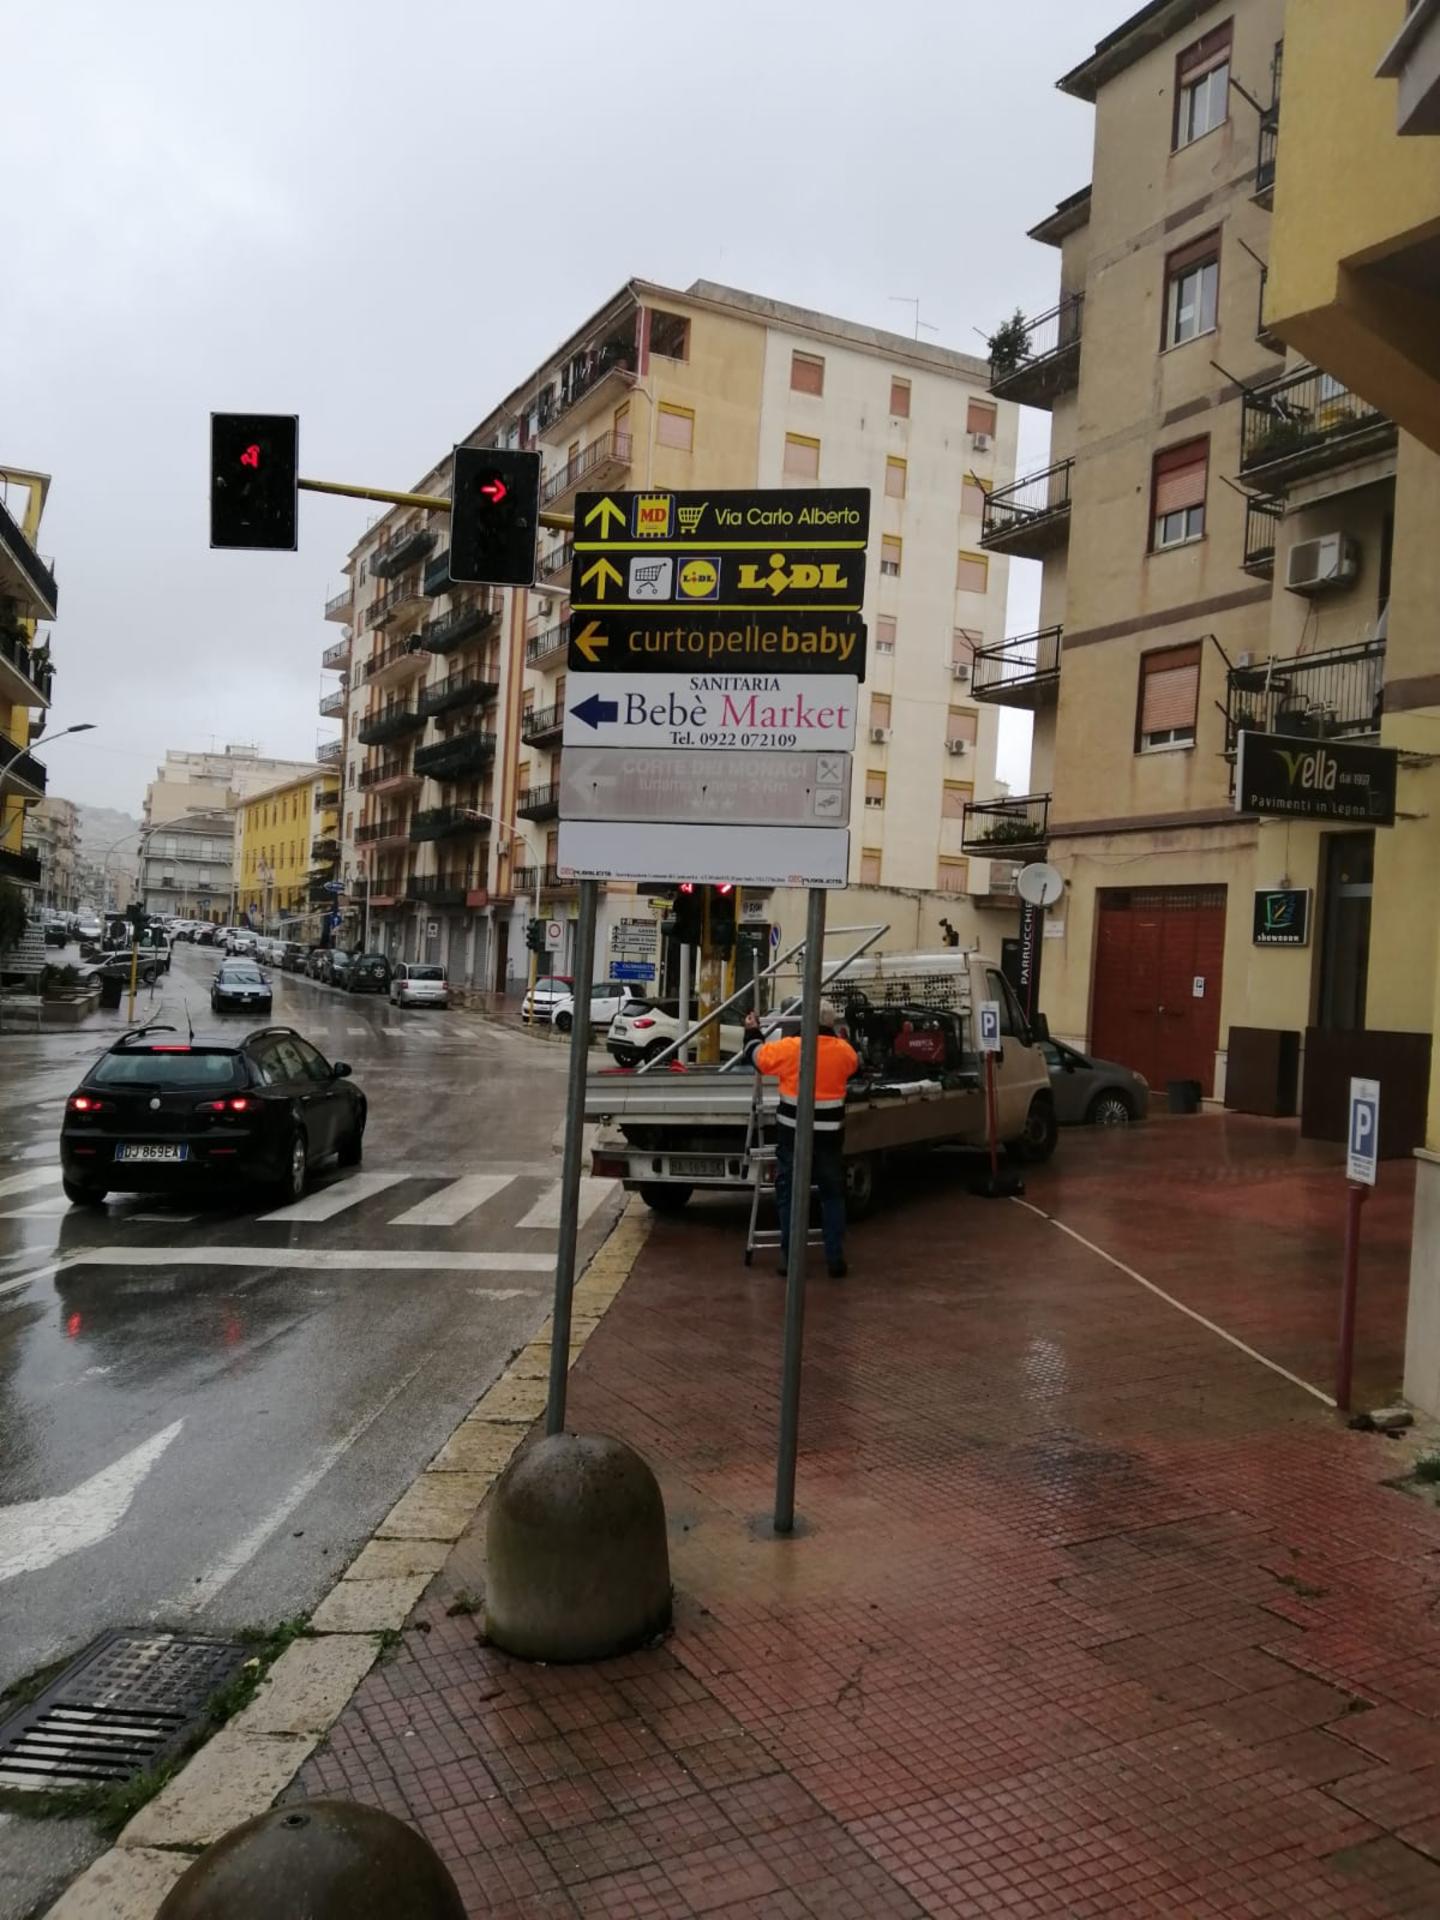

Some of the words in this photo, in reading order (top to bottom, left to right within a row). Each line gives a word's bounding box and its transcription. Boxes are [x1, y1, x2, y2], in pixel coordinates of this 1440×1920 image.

[640, 508, 667, 523] MD
[715, 508, 742, 526] Via
[747, 507, 794, 526] Carlo
[798, 507, 860, 526] Alberto
[628, 625, 857, 661] curtopellebaby
[689, 677, 781, 692] SANITARIA
[624, 692, 707, 727] Bebè
[720, 694, 849, 729] Market
[669, 731, 695, 746] Tel.
[700, 732, 736, 747] 0922
[741, 733, 797, 748] 072109
[1275, 750, 1338, 790] Vella
[1250, 794, 1311, 812] Pavimenti
[1316, 802, 1328, 813] in
[1332, 802, 1367, 818] Legno
[984, 1013, 996, 1037] P
[1356, 1103, 1372, 1151] P
